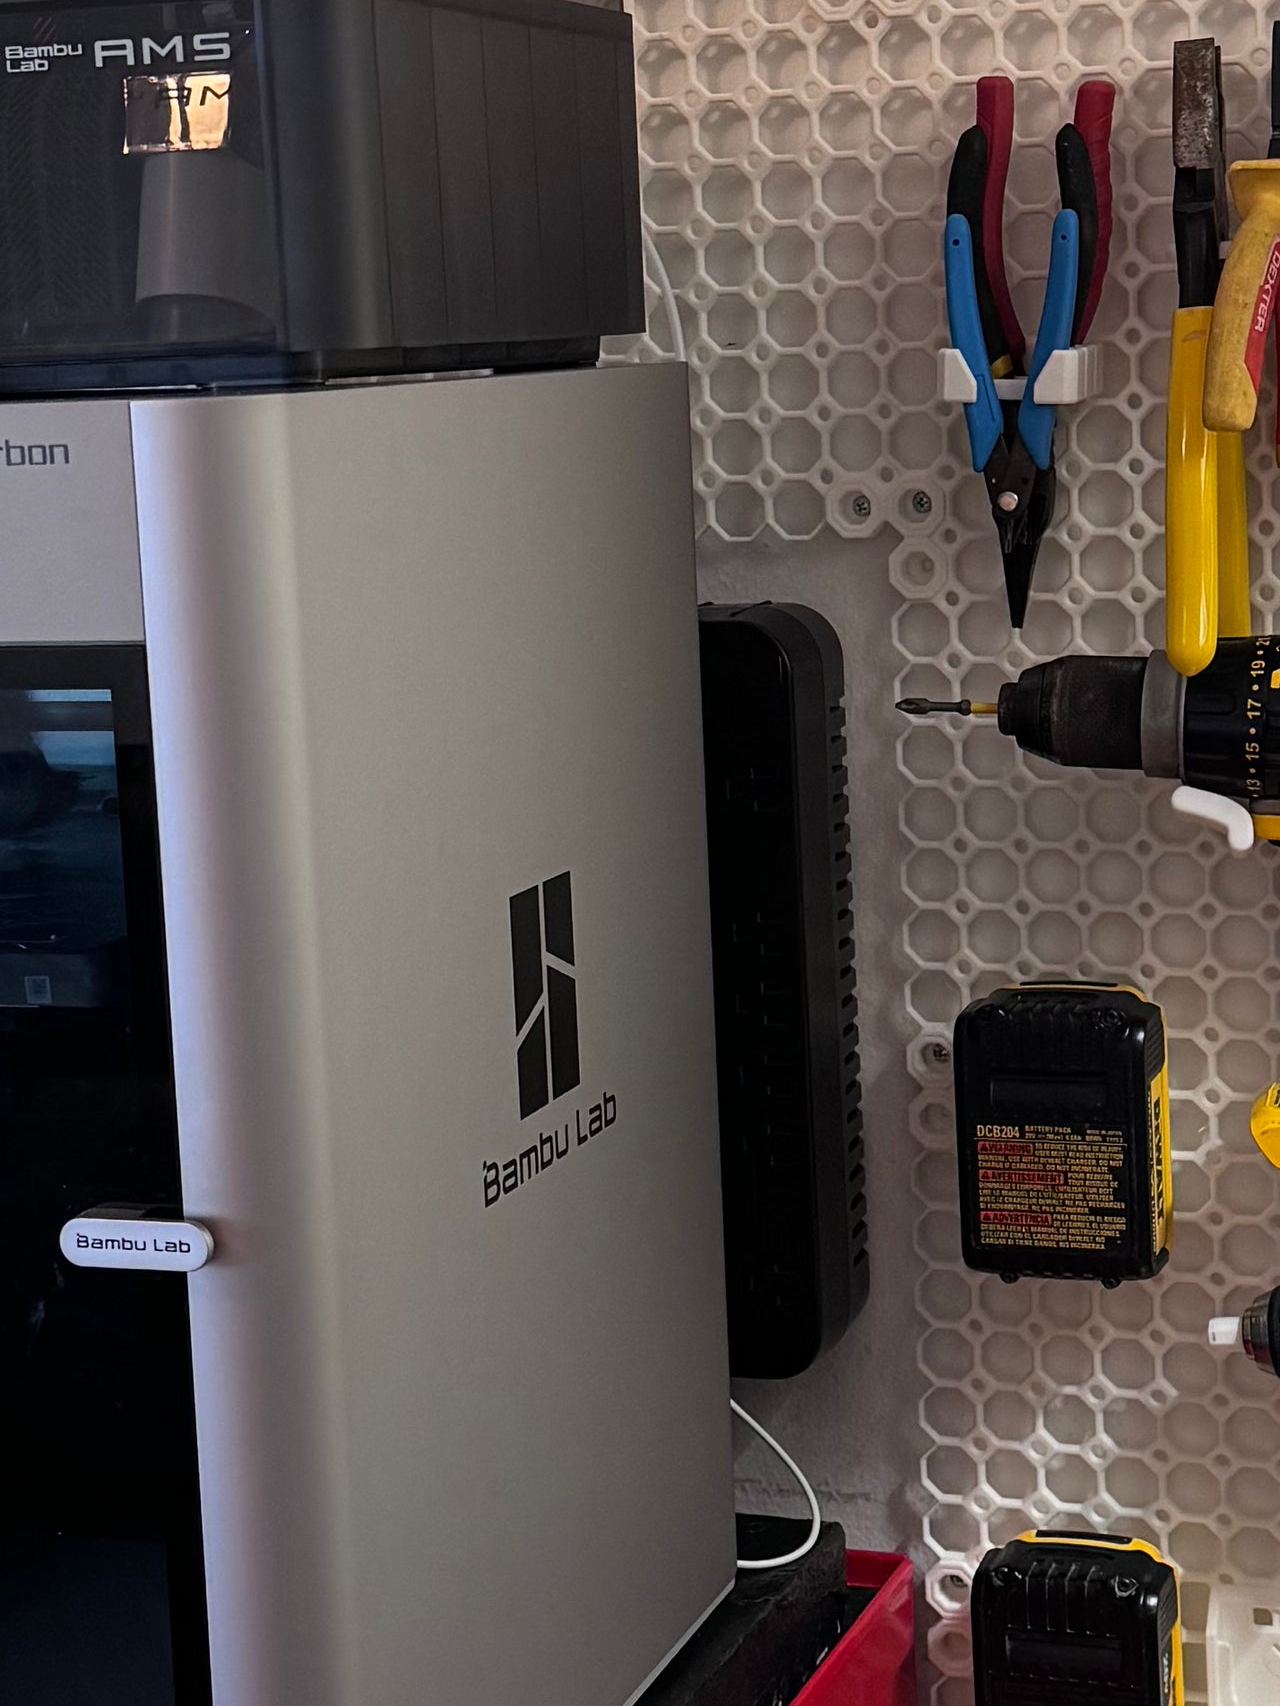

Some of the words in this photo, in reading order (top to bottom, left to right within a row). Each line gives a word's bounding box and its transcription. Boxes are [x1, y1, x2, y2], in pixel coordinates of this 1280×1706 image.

[4, 43, 83, 60] Bambu
[94, 32, 231, 67] AMS
[6, 58, 49, 73] Lab
[1255, 251, 1280, 332] DEXTER
[1251, 660, 1266, 677] 19
[1247, 699, 1262, 719] 17
[1245, 742, 1260, 761] 15
[977, 1125, 1020, 1137] DCB204
[483, 1124, 569, 1208] Bambu
[576, 1091, 617, 1146] Lab
[76, 1233, 147, 1251] Bambu
[154, 1239, 191, 1253] Lab
